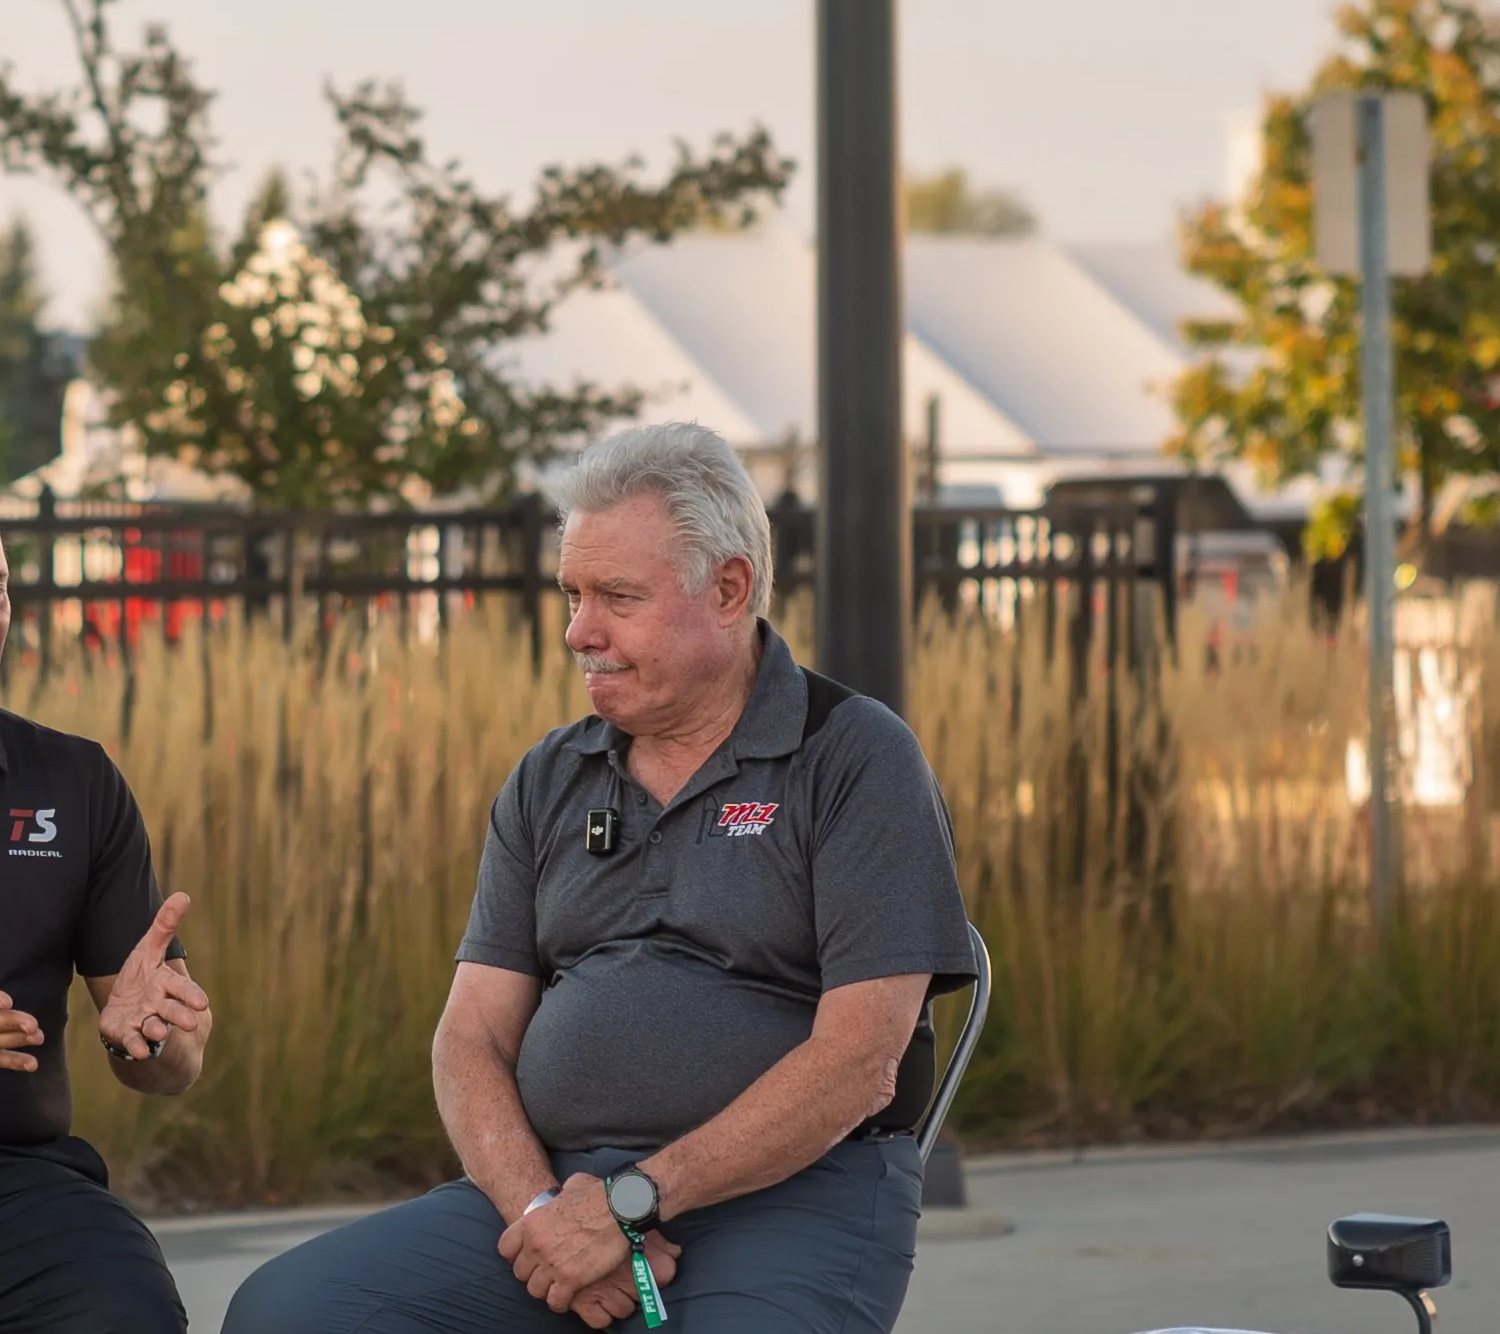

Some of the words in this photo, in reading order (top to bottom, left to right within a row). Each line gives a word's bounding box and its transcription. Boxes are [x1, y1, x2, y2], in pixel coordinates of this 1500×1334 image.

[9, 808, 57, 843] TS
[727, 823, 767, 836] TEAM
[8, 848, 63, 858] RADICAL
[633, 1260, 651, 1292] LANE
[643, 1294, 656, 1314] PIT
